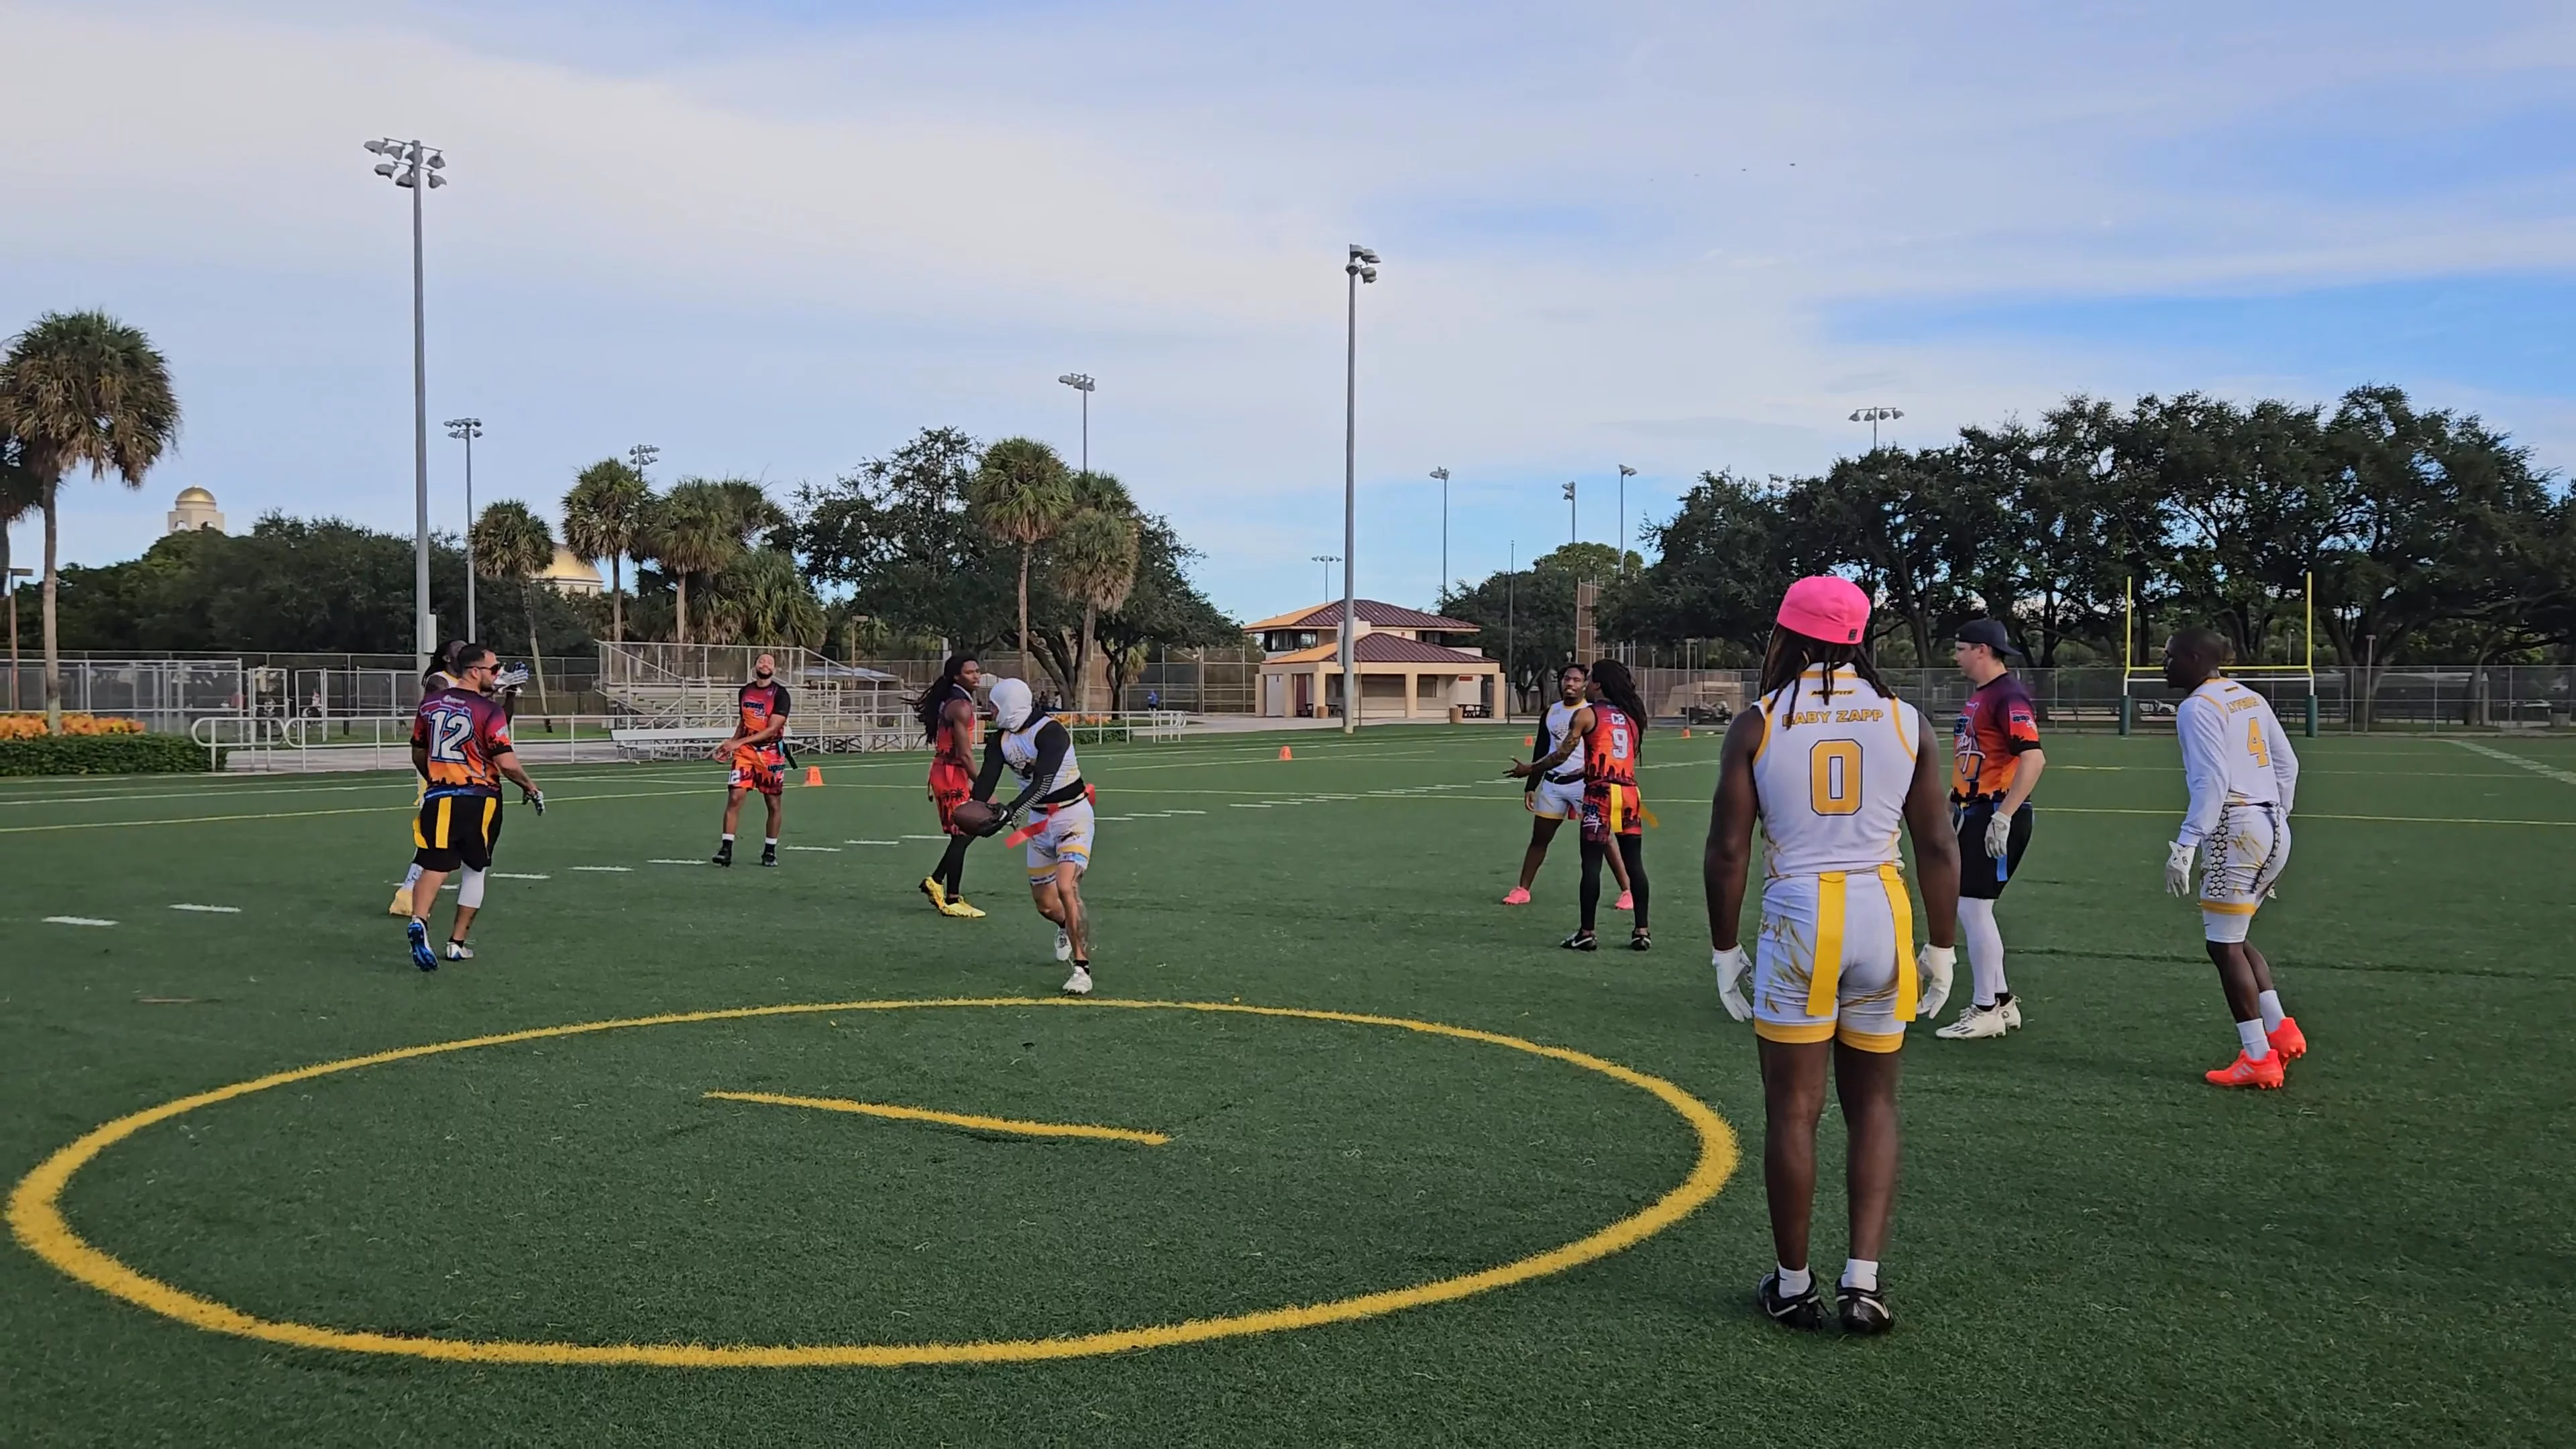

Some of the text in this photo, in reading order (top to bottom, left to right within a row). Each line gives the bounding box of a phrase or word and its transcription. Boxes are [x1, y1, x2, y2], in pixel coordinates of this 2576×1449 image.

[429, 708, 474, 763] 12
[1835, 708, 1884, 722] ZAPP
[1611, 728, 1629, 759] 9
[2247, 716, 2270, 767] 4
[1809, 738, 1864, 816] 0
